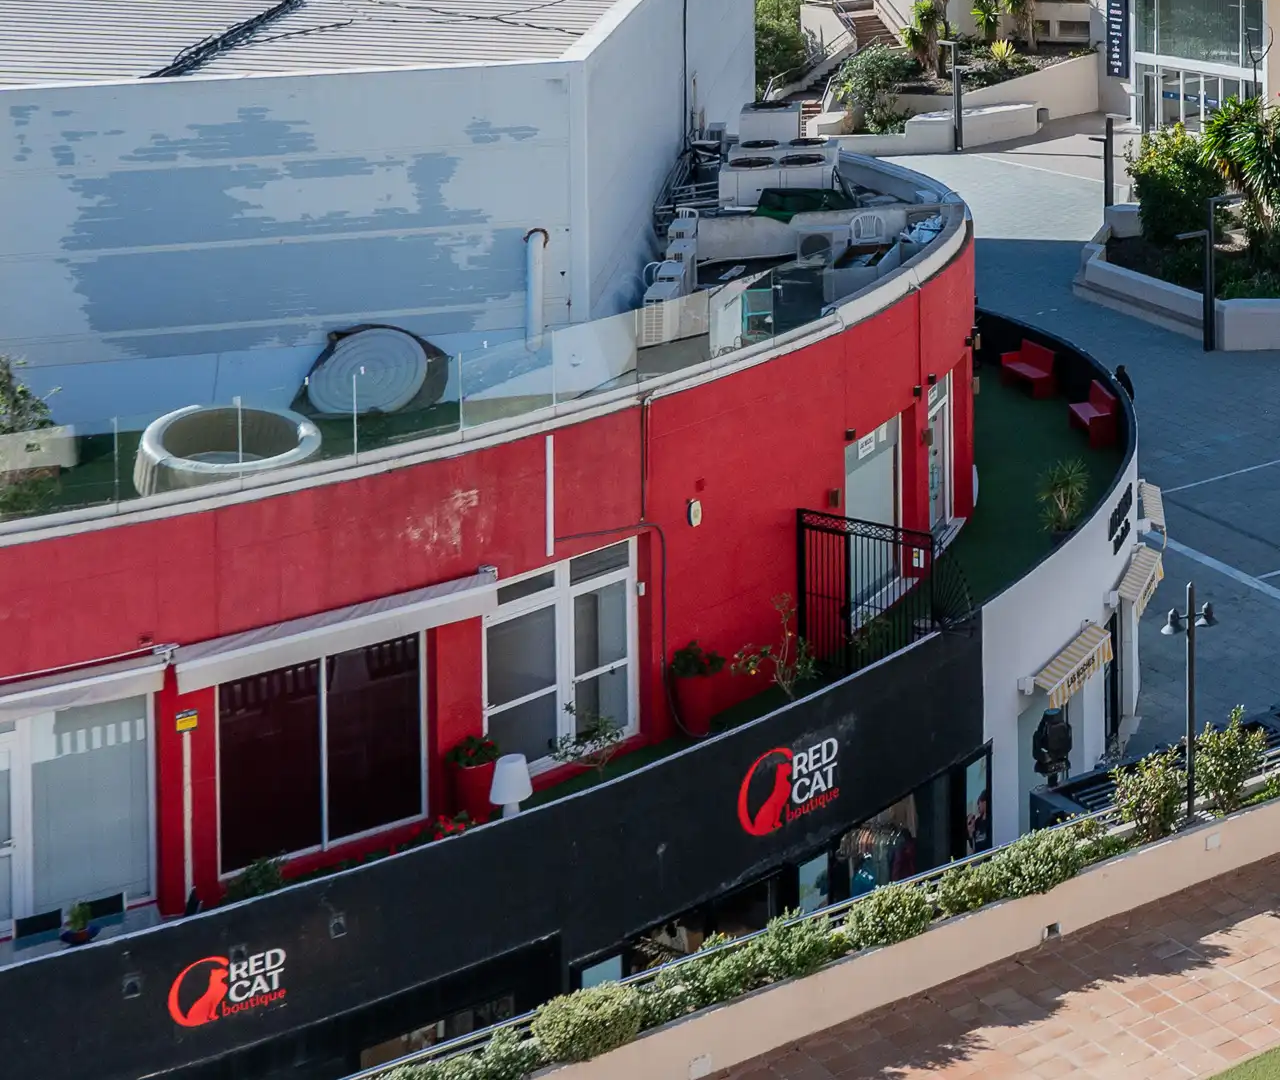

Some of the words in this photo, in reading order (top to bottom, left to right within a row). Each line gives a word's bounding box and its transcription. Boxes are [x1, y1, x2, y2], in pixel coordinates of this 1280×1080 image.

[791, 737, 839, 780] RED
[791, 761, 838, 804] CAT
[786, 787, 840, 822] boutique
[229, 948, 287, 982] RED
[228, 967, 285, 1002] CAT
[222, 988, 287, 1017] boutique
